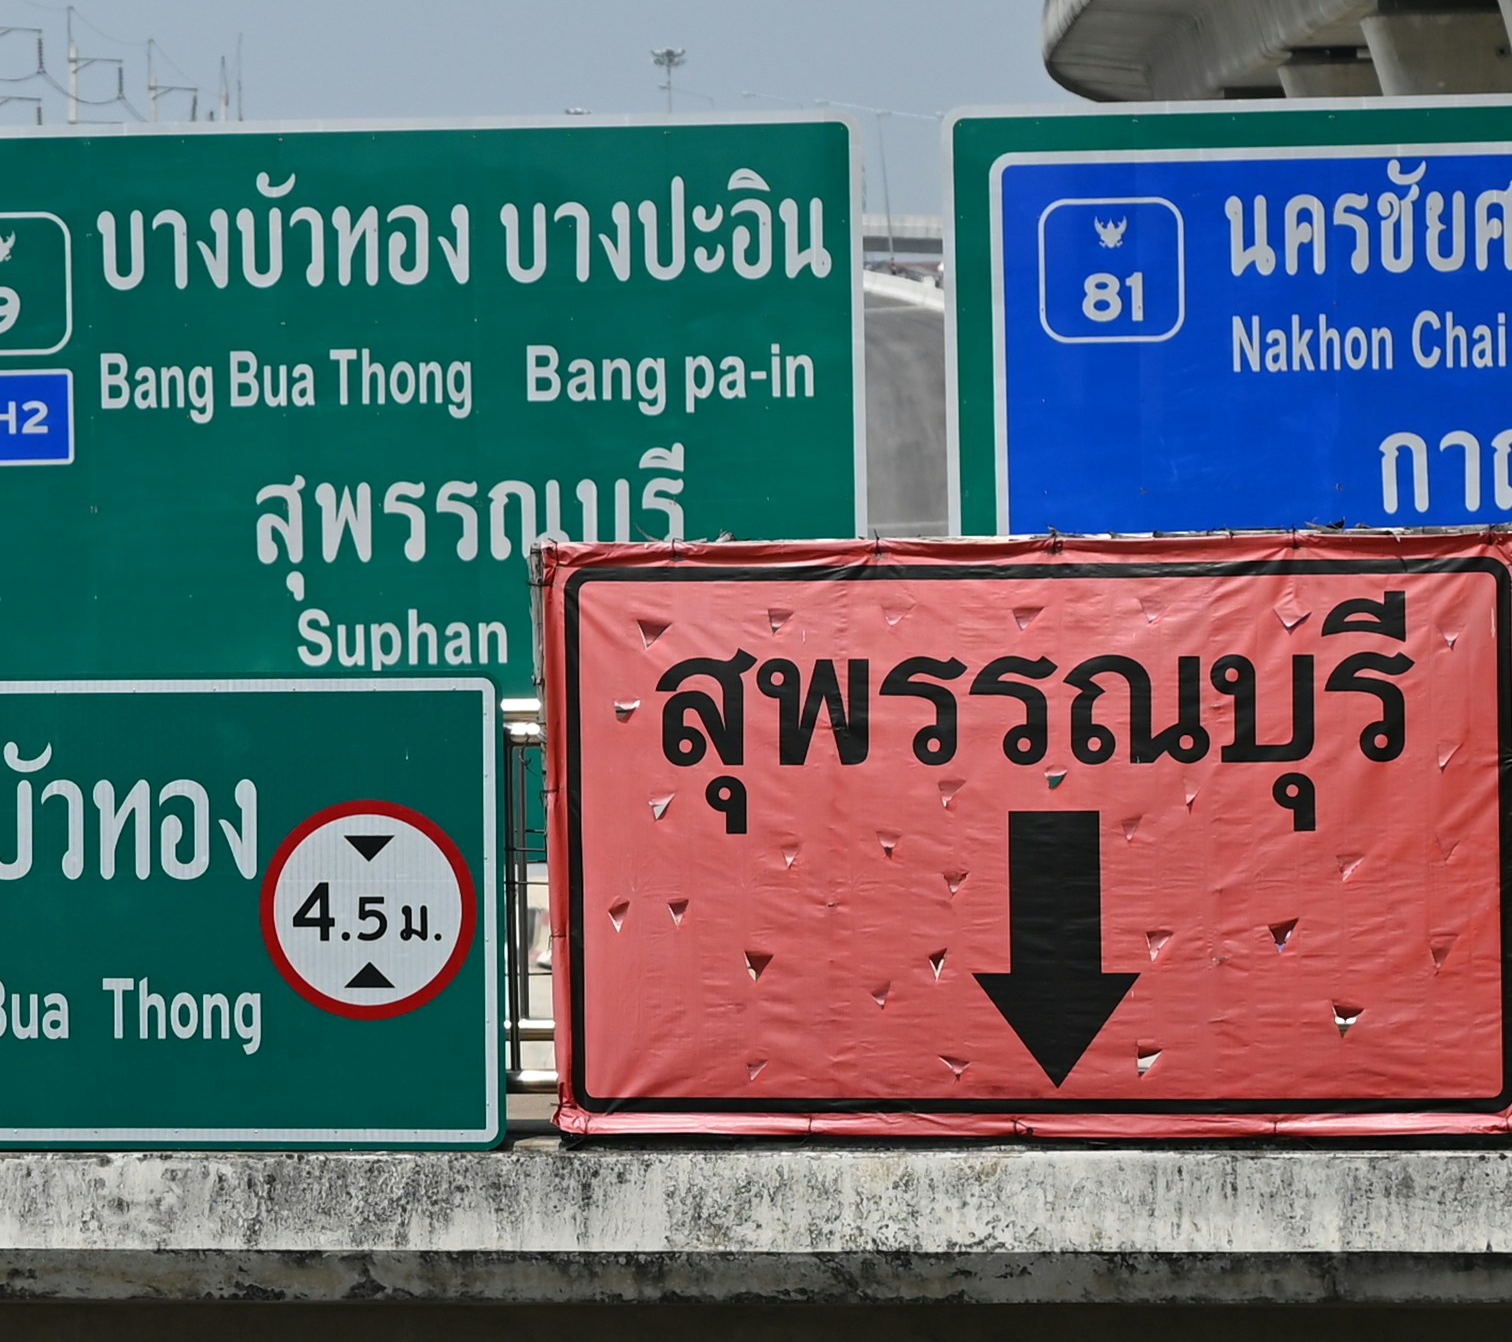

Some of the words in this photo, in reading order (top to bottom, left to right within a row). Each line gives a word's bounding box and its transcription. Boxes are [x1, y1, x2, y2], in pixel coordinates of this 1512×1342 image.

[96, 171, 471, 291] บางบัวทอง
[500, 167, 833, 284] บางปะอิน
[1082, 272, 1145, 323] 81
[1232, 311, 1394, 373] Nakhon
[1412, 310, 1508, 370] Chai
[100, 352, 214, 424] Bang
[229, 349, 317, 408] Bua
[328, 347, 473, 419] Thong
[525, 344, 667, 416] Bang
[685, 343, 815, 413] pa-in
[297, 608, 509, 672] Suphan
[655, 590, 1416, 834] สุพรรณบุรี
[102, 977, 263, 1056] Thong
